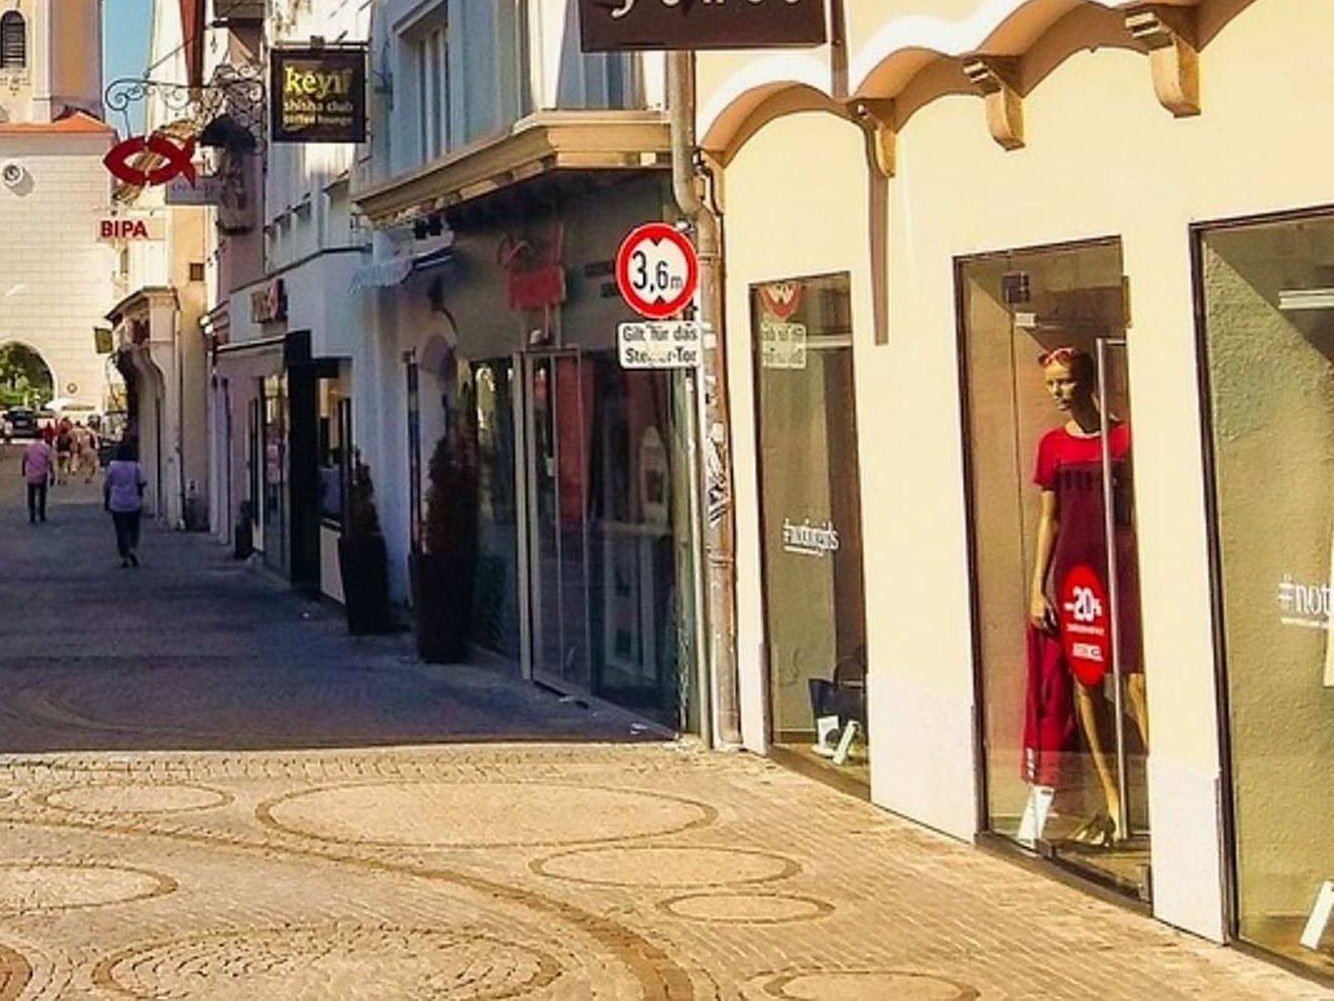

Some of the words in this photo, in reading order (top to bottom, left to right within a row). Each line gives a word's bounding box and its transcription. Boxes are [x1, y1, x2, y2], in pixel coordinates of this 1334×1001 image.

[100, 219, 148, 238] BIPA
[623, 325, 646, 341] Gilt
[650, 324, 669, 341] für
[673, 324, 698, 341] das
